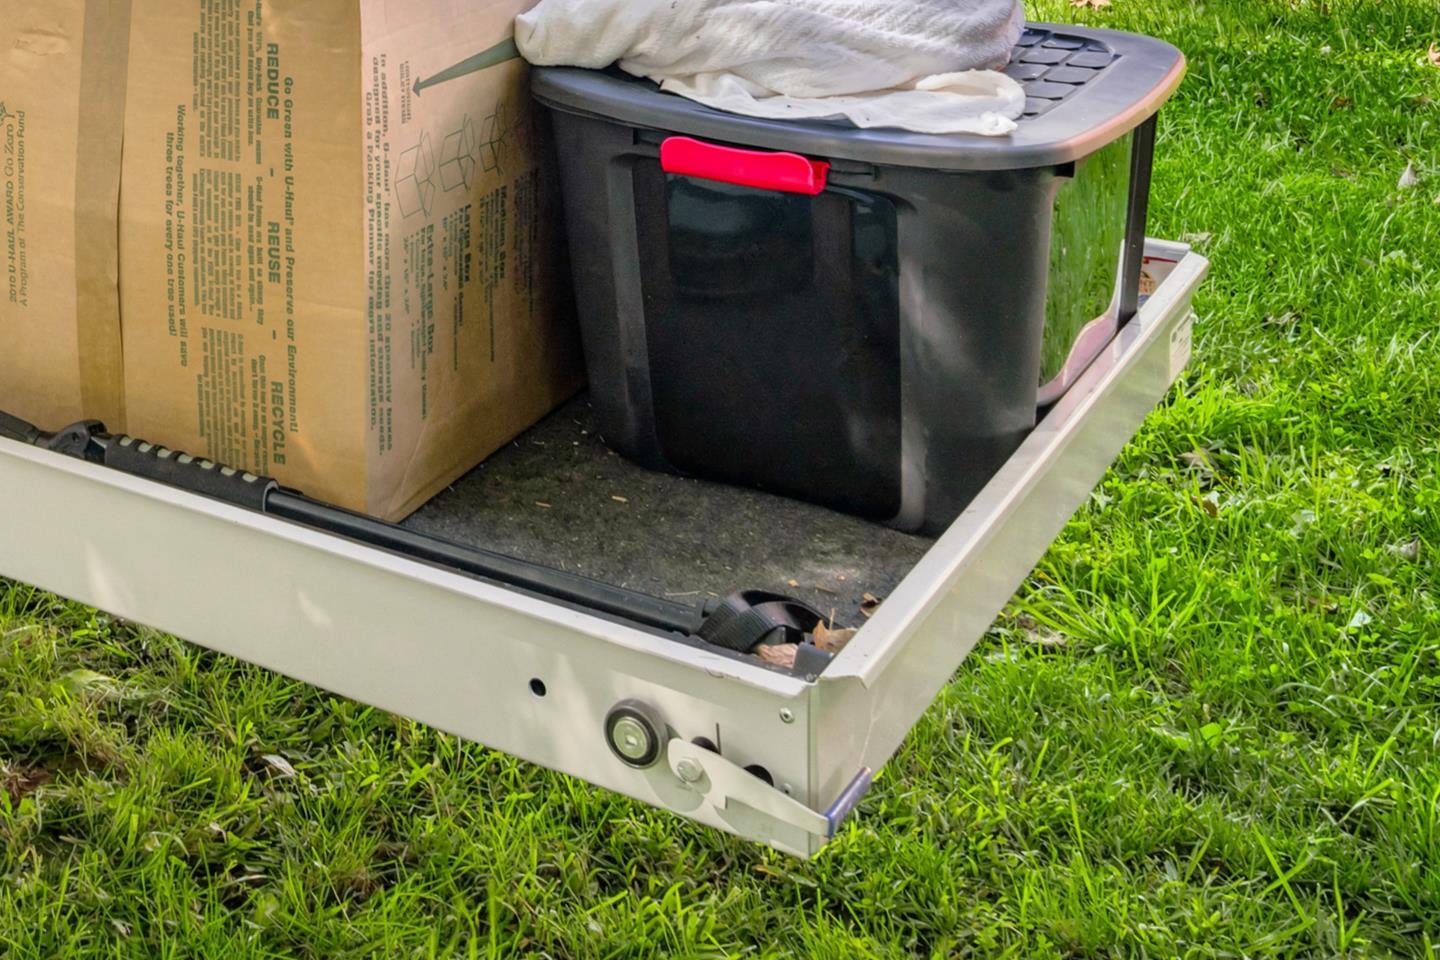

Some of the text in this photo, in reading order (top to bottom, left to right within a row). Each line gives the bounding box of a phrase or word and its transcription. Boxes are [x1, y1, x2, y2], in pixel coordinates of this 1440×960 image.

[284, 76, 294, 95] Go
[16, 110, 25, 139] Fund
[176, 104, 186, 152] Working
[283, 99, 294, 139] Green
[166, 132, 174, 163] three
[284, 142, 294, 172] with
[16, 140, 25, 211] Conservation
[165, 166, 173, 196] trees
[175, 154, 185, 207] together,
[6, 180, 15, 225] AWARD
[165, 199, 174, 216] for
[17, 211, 26, 233] The
[164, 219, 173, 252] every
[176, 210, 185, 250] U-Haul
[7, 227, 16, 274] U-HAUL
[266, 43, 286, 465] REDUCE REUSE RECYCLE
[284, 227, 295, 252] and
[18, 249, 29, 297] Program
[165, 254, 173, 275] one
[166, 278, 175, 302] tree
[177, 253, 187, 315] Customers
[285, 256, 295, 315] Preserve
[179, 317, 188, 338] will
[286, 318, 295, 341] our
[287, 344, 298, 433] Environment!
